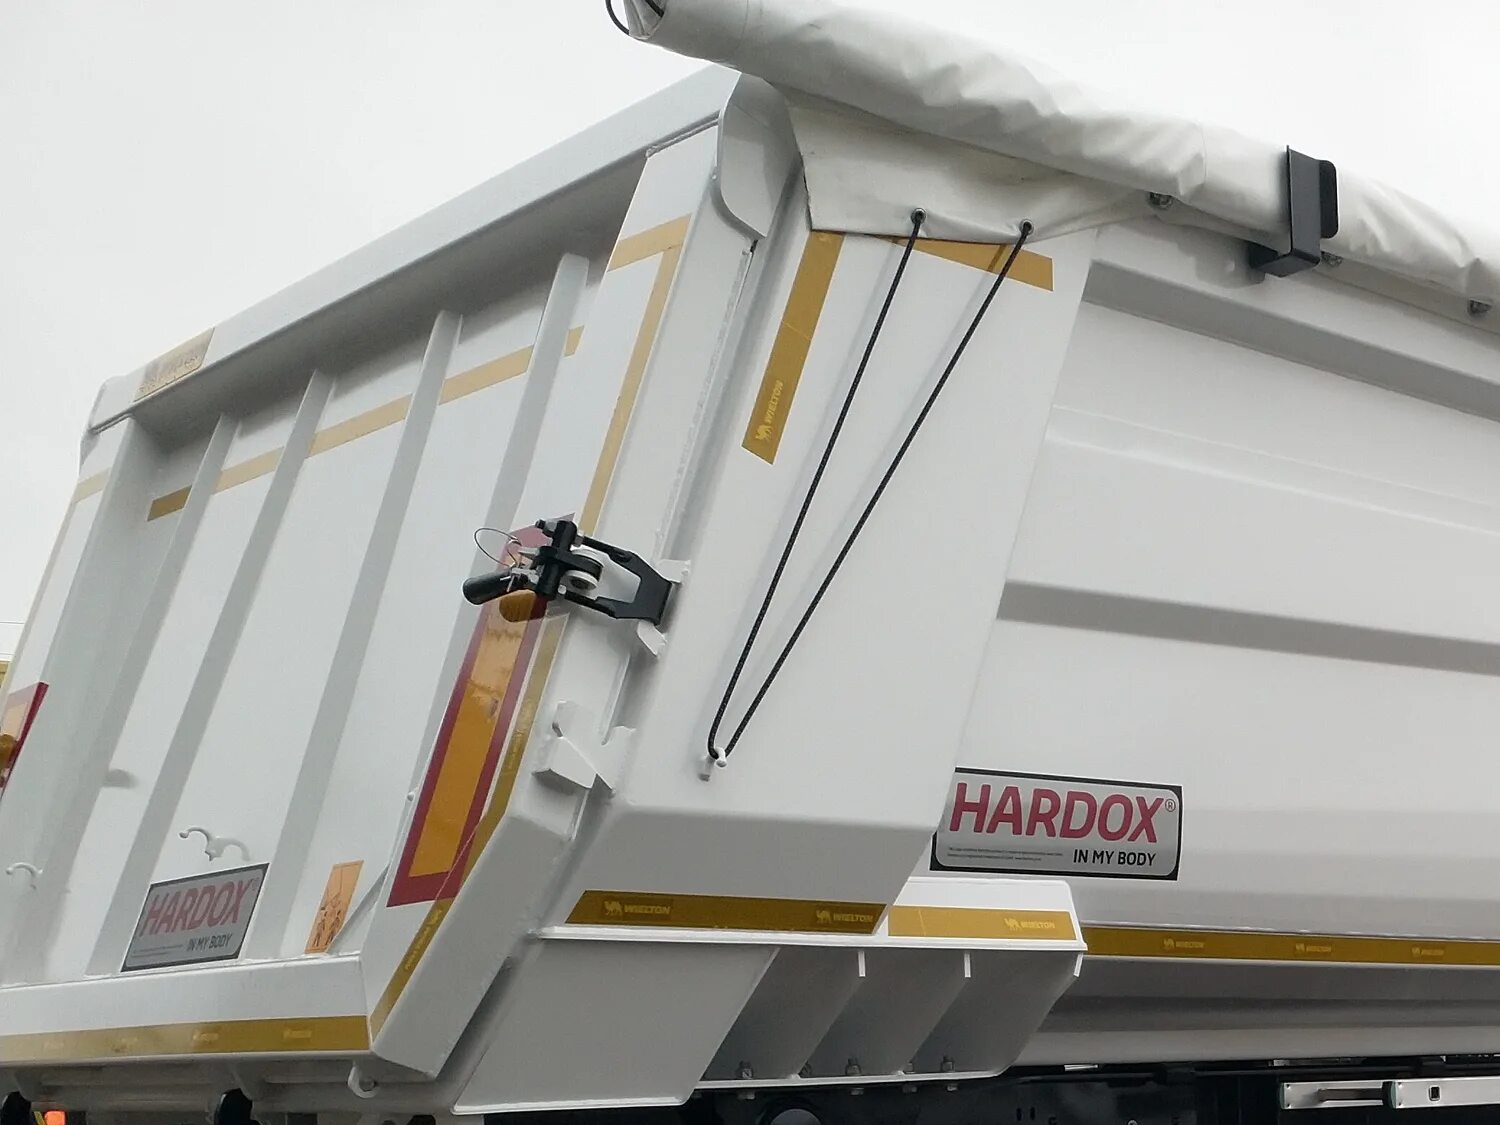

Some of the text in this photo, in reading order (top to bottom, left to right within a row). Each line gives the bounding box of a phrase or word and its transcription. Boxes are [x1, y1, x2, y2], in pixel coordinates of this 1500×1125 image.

[764, 379, 784, 425] WIELTON
[1073, 849, 1089, 863] IN
[1092, 850, 1115, 865] MY
[1117, 851, 1157, 867] BODY
[141, 879, 251, 936] HARDOX
[624, 903, 671, 915] WIELTON
[209, 934, 233, 949] BODY
